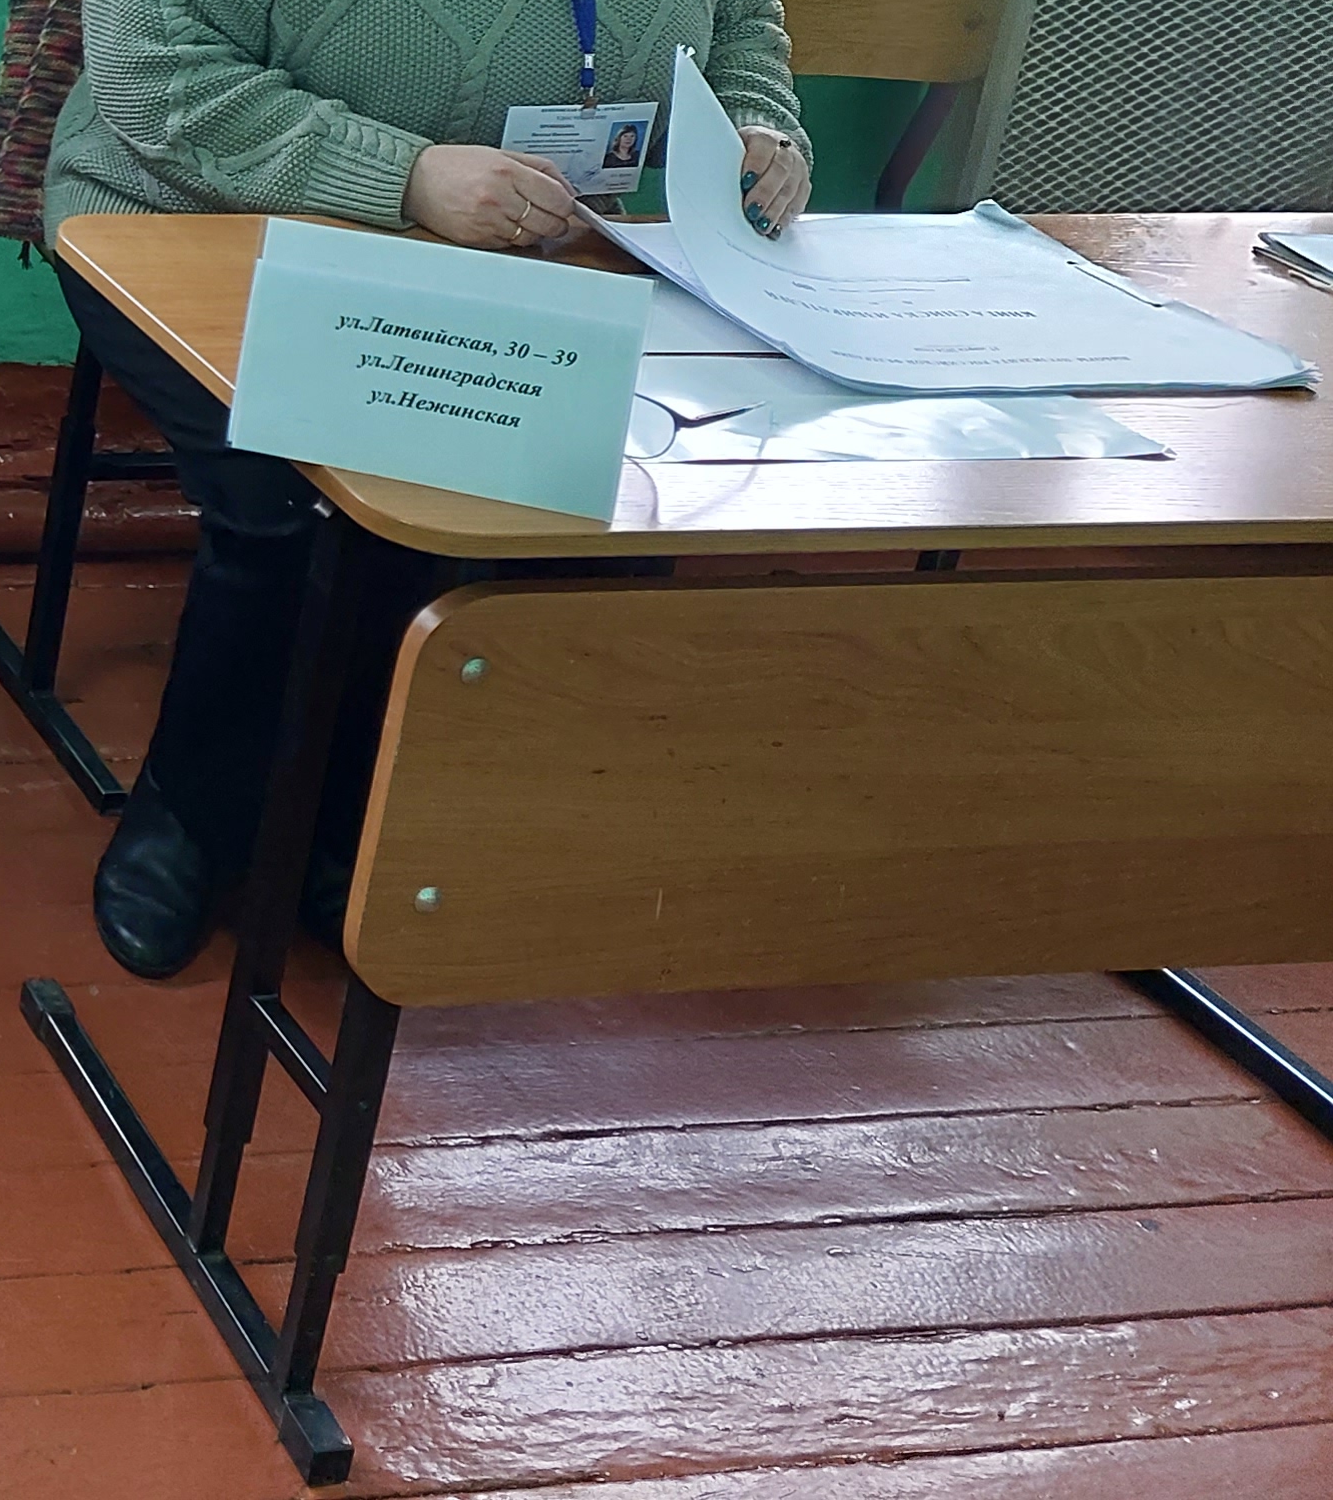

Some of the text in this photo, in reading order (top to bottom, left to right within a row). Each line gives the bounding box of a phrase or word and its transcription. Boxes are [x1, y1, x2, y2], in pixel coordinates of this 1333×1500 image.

[336, 315, 499, 356] ул.Латвийская,
[504, 341, 531, 360] 30
[551, 349, 578, 368] 39
[356, 353, 544, 397] ул.Ленинградская
[366, 388, 522, 428] ул.Нежинская
